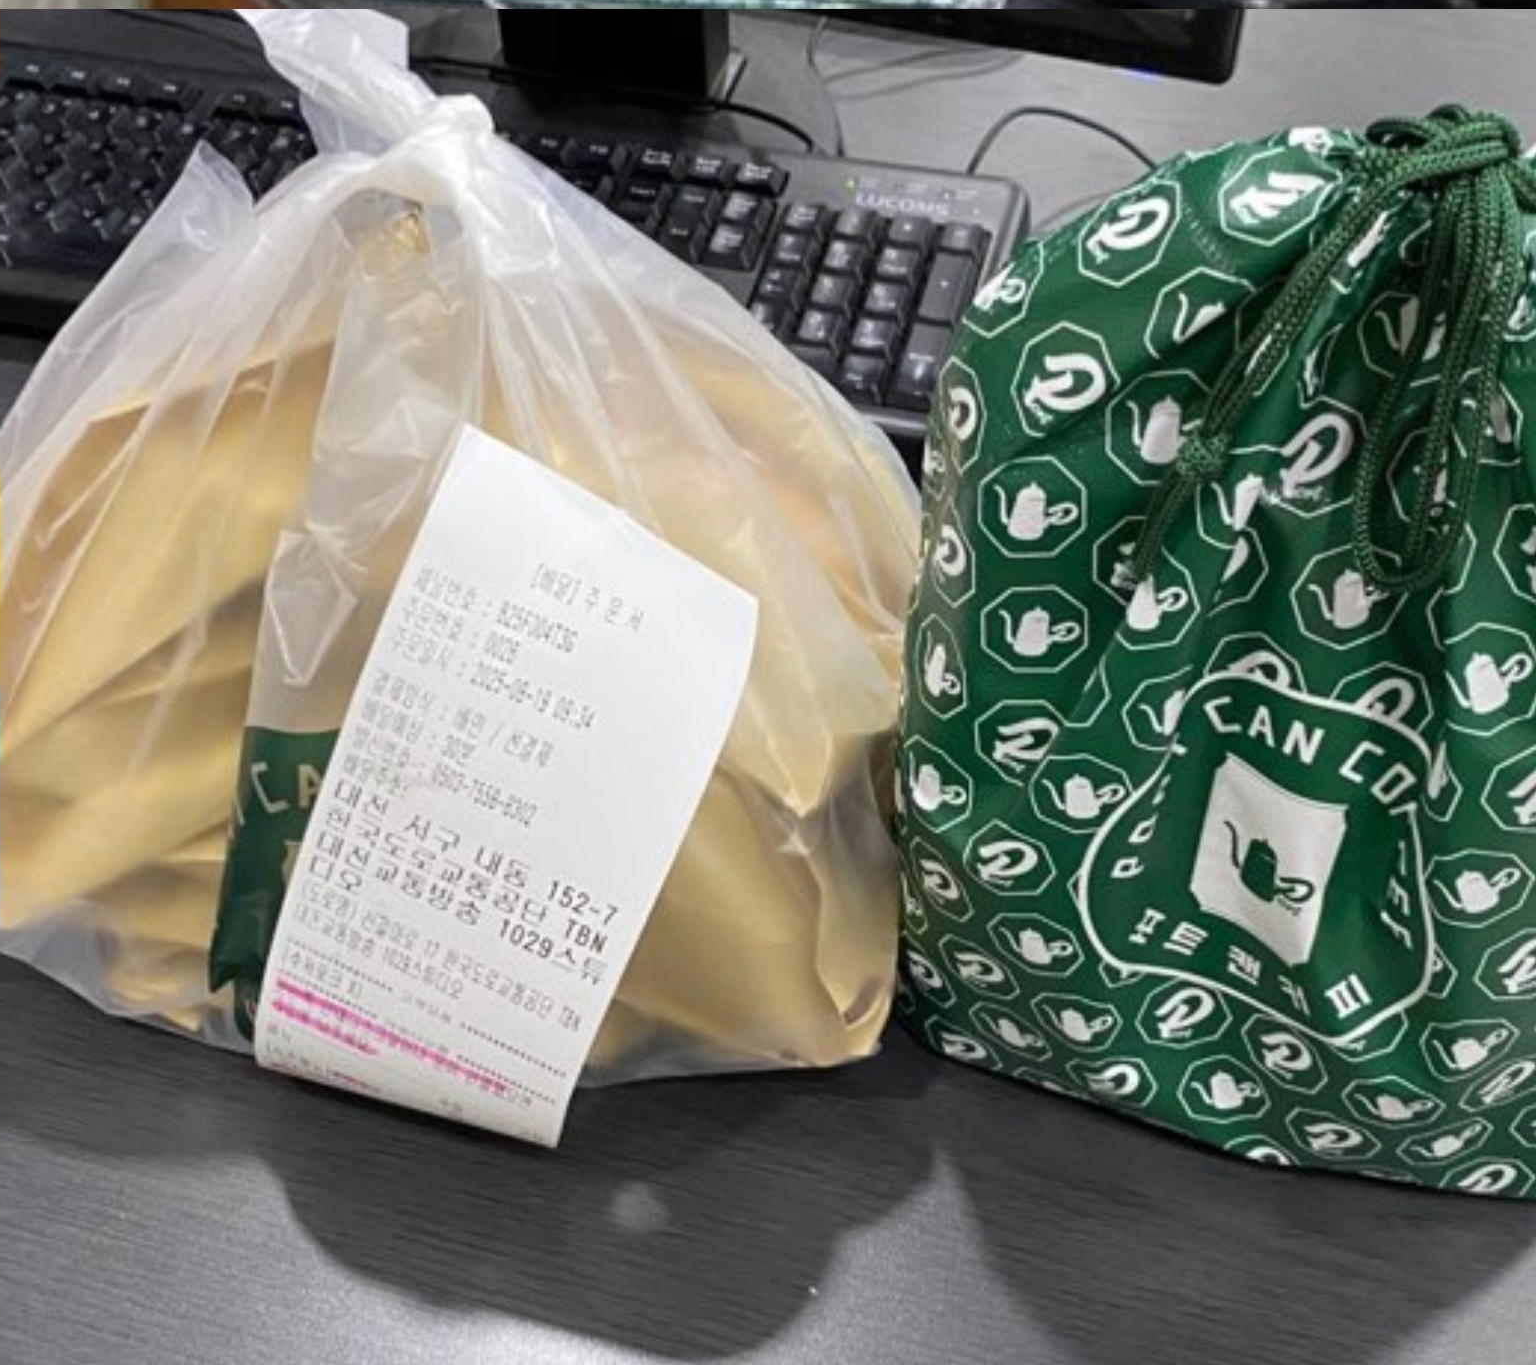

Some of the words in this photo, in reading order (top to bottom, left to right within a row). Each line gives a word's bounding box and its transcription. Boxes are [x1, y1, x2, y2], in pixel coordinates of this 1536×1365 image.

[1203, 695, 1325, 766] CAN
[311, 855, 362, 892] 디오
[316, 830, 482, 926] 대전교통방송
[499, 918, 607, 986] 1029스튜
[326, 809, 548, 926] 한국도로교통공단
[564, 919, 608, 954] TBN
[333, 779, 389, 816] 대전
[404, 815, 461, 852] 서구
[473, 846, 531, 888] 내동
[547, 879, 619, 926] 152-7
